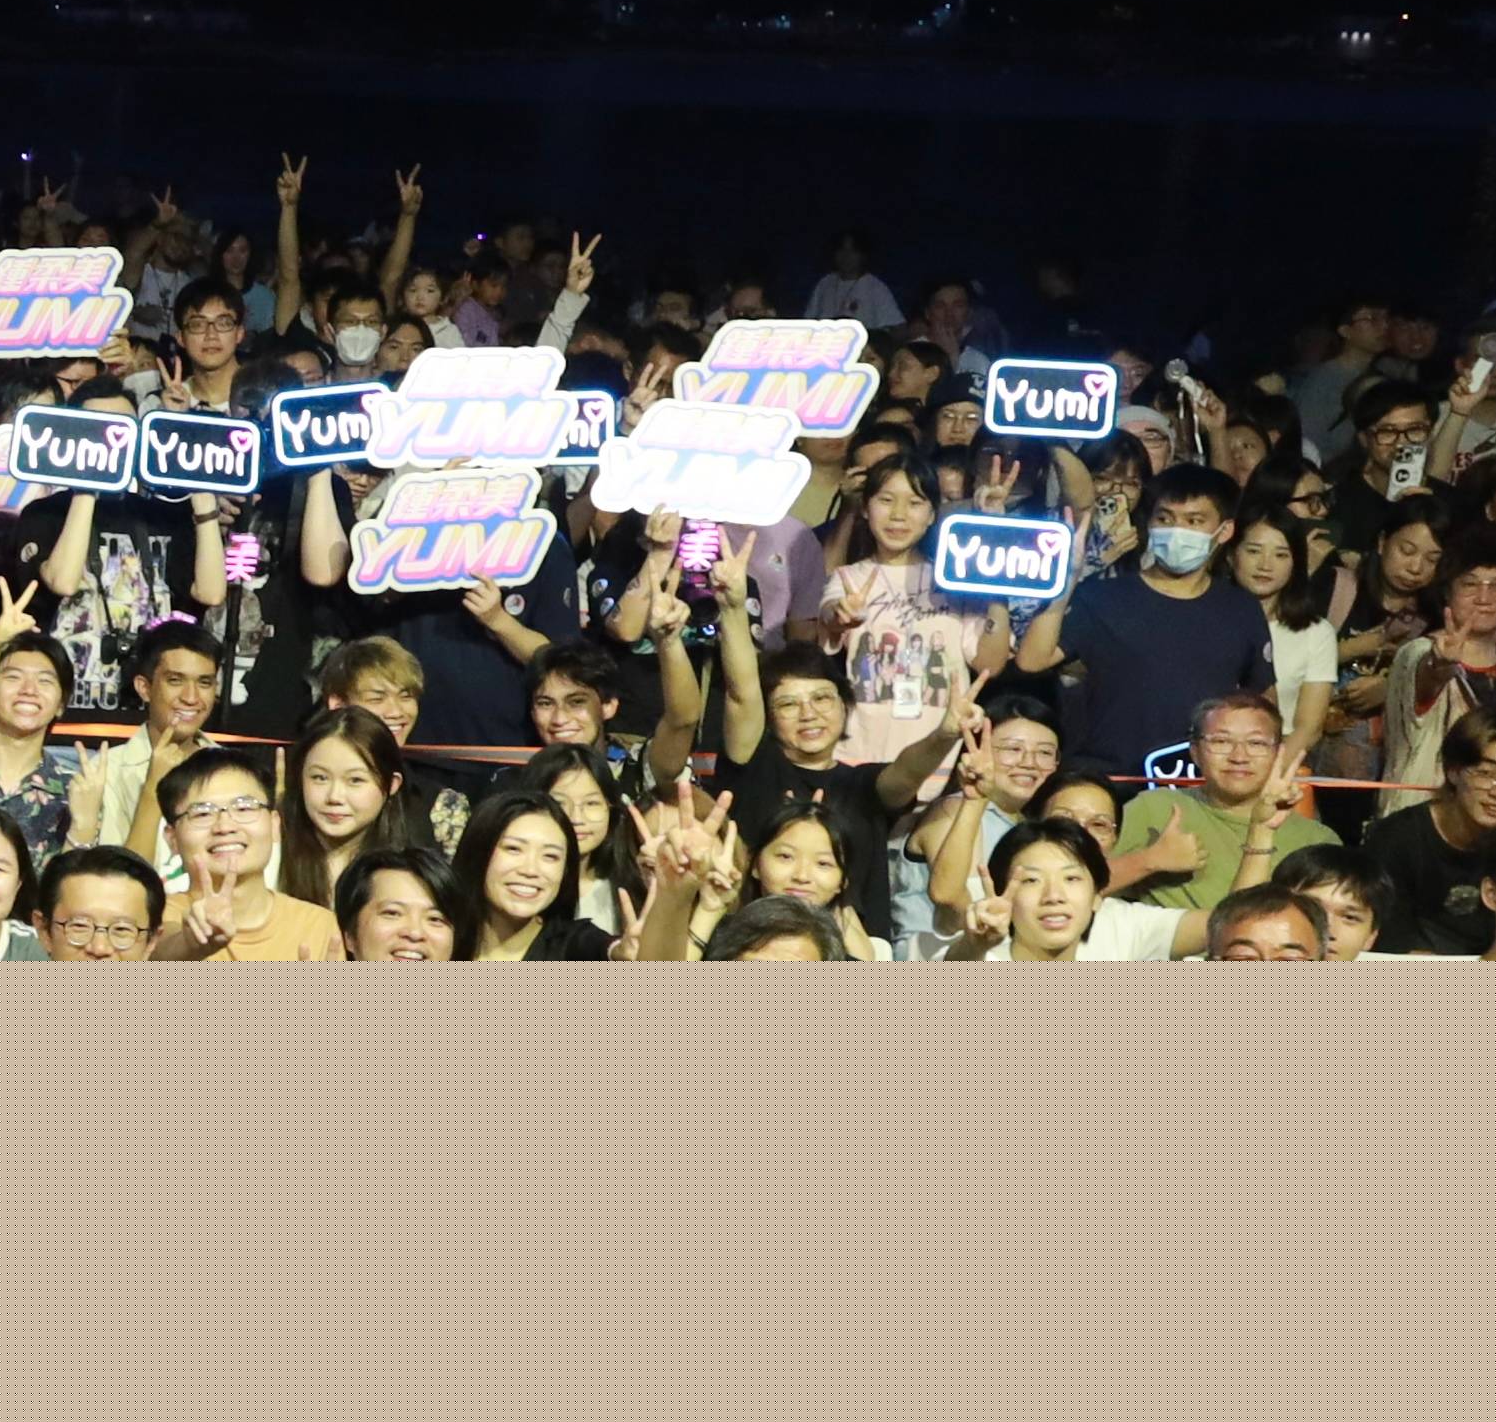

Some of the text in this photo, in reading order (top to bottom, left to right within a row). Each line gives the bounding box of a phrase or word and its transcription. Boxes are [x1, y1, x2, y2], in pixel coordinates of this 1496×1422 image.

[709, 327, 859, 370] 鍾柔美
[997, 374, 1109, 422] Yumi
[22, 425, 129, 473] Yumi
[280, 399, 374, 453] Yum
[375, 399, 571, 458] YUMI
[150, 429, 253, 476] Yumi
[386, 474, 532, 526] 鍾柔美
[356, 518, 551, 585] YUMI
[948, 532, 1060, 581] Yumi
